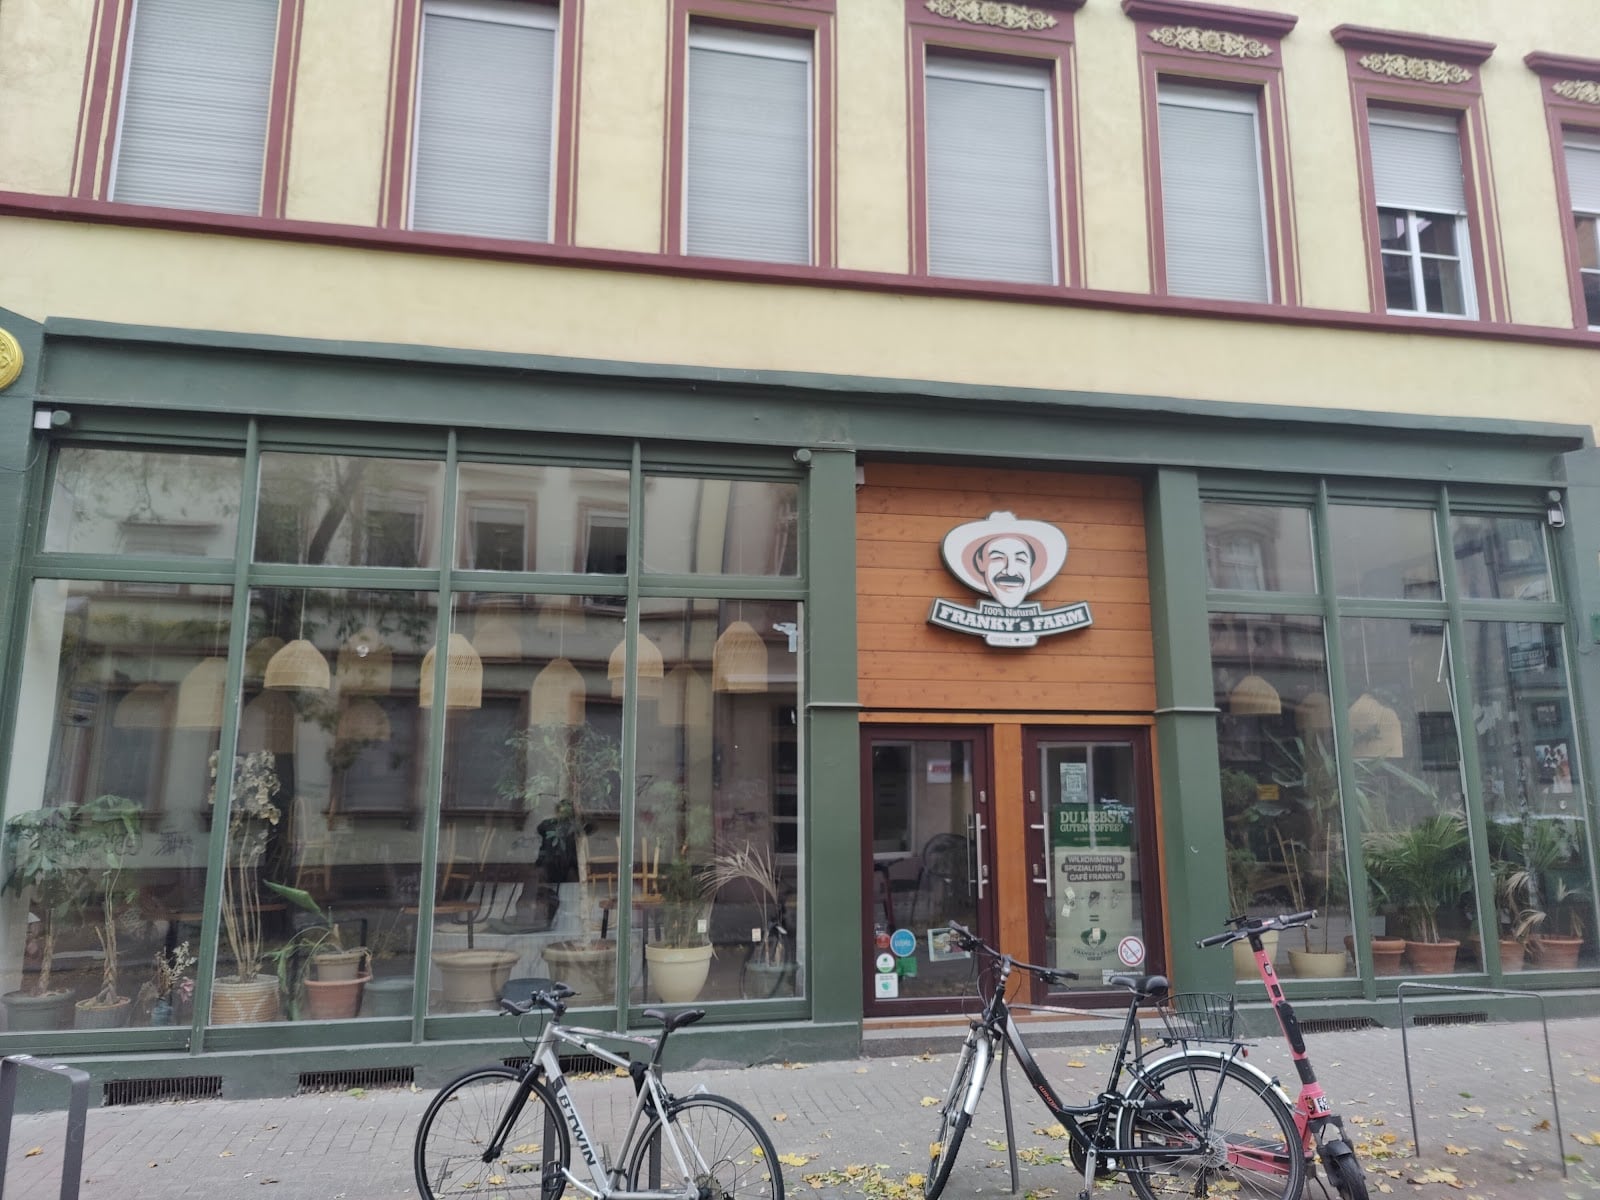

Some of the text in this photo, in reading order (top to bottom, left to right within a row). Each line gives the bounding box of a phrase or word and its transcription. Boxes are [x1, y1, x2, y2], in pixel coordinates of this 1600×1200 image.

[1005, 607, 1038, 617] Natural
[1033, 608, 1086, 630] FARM
[1060, 811, 1079, 823] DU
[1060, 824, 1088, 833] GUTEN
